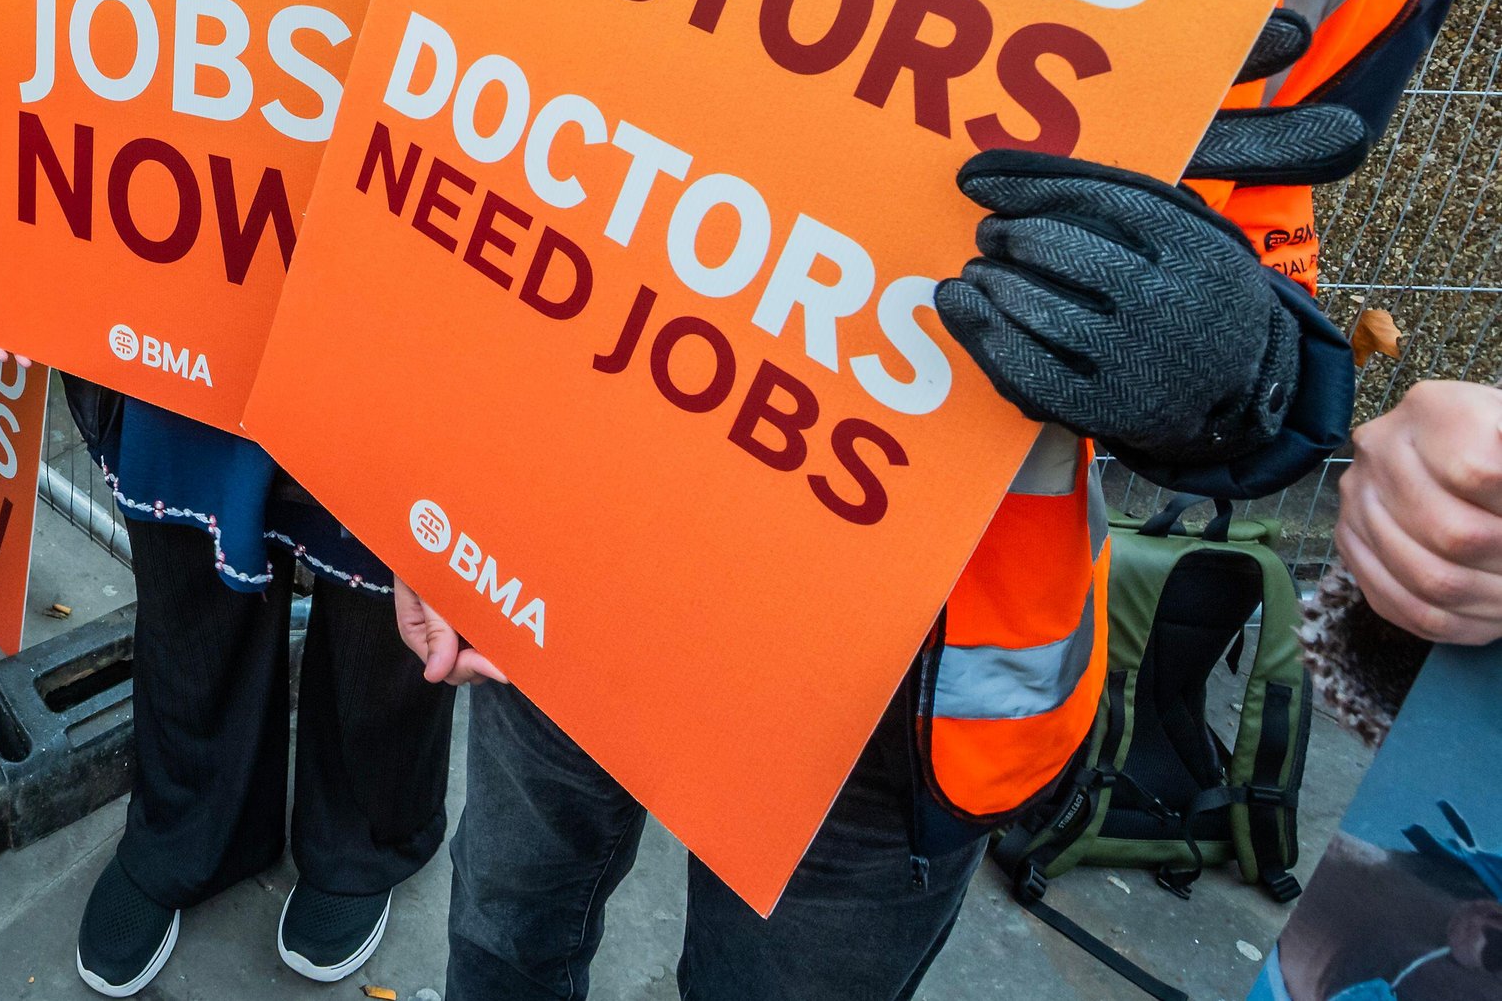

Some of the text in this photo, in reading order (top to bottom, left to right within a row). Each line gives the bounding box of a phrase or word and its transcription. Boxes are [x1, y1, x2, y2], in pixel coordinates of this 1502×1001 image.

[17, 110, 297, 286] NOW
[382, 11, 953, 416] DOCTORS
[141, 334, 214, 388] BMA
[355, 120, 910, 526] NEED JOBS
[448, 531, 546, 648] BMA
